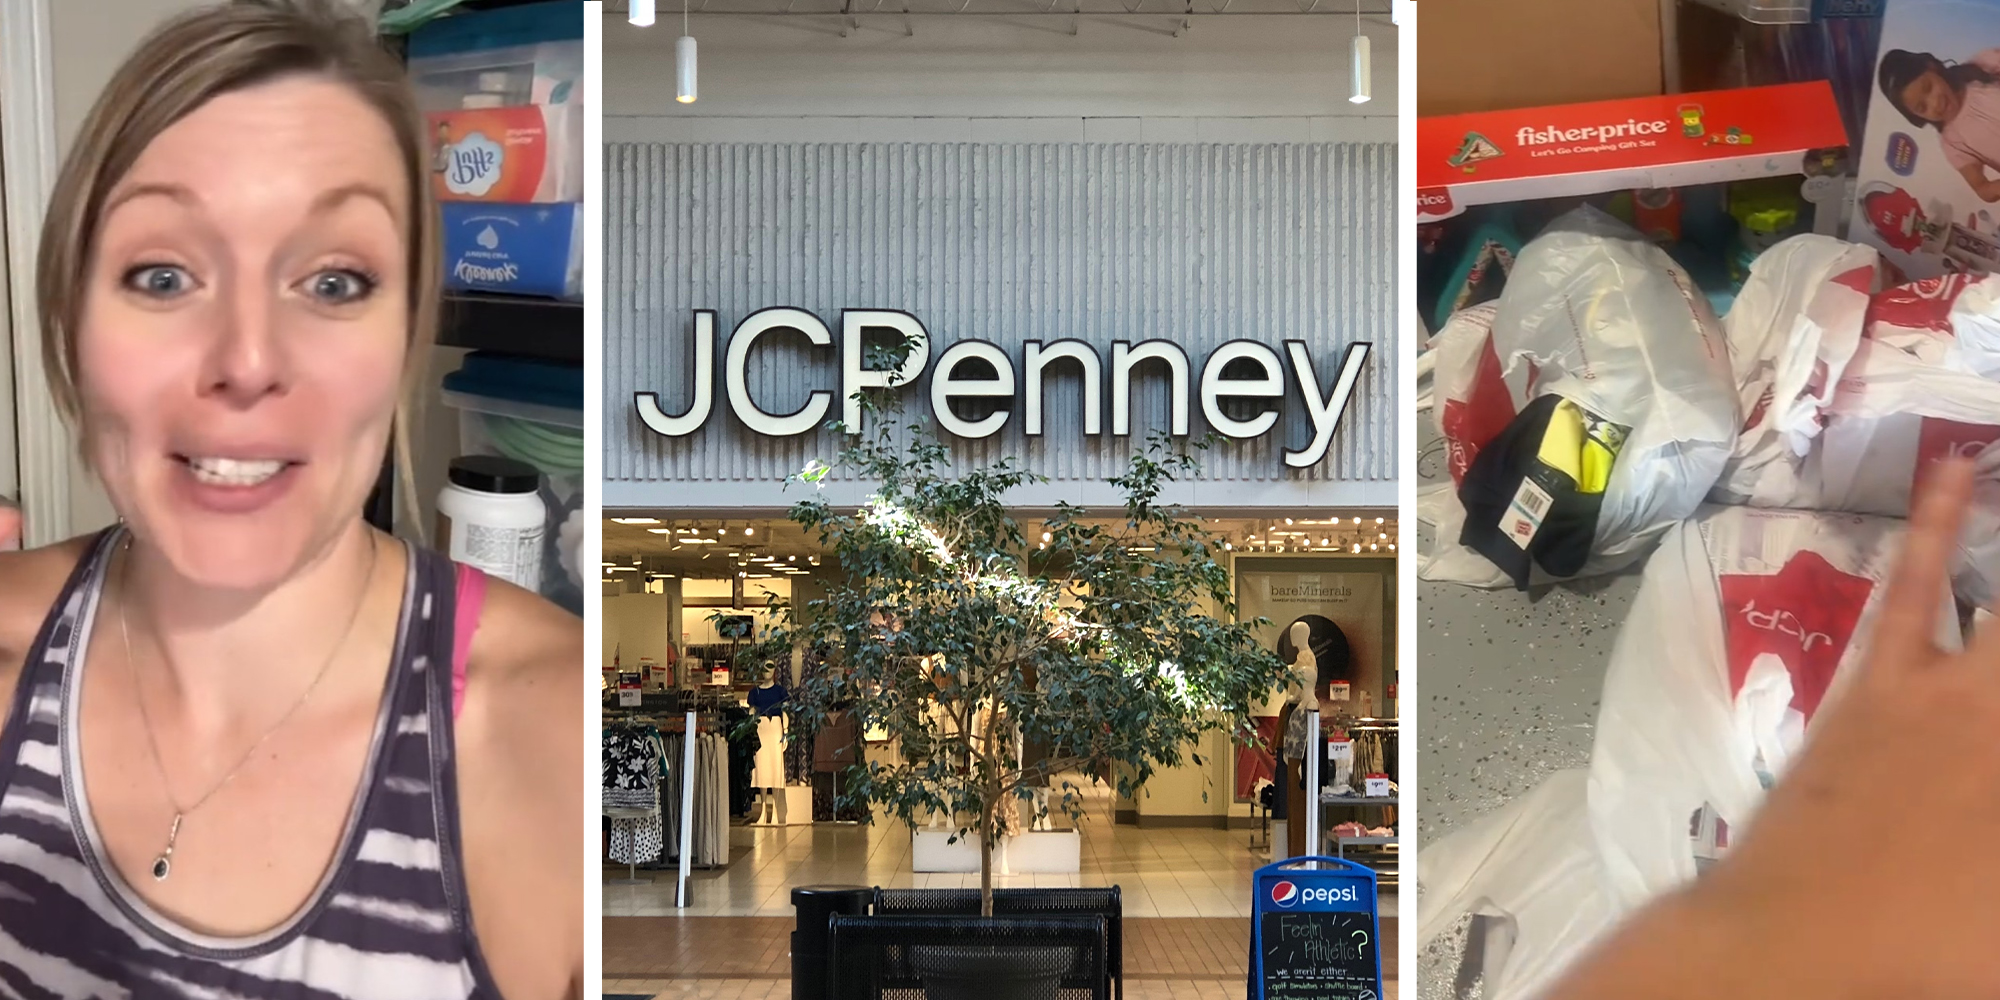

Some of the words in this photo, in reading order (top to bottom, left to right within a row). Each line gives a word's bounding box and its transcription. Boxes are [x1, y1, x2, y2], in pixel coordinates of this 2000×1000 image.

[1515, 119, 1667, 146] fisher-price
[1557, 147, 1572, 156] Go
[1573, 143, 1618, 155] Camping
[1619, 141, 1638, 150] Gift
[1639, 139, 1657, 148] Set
[634, 306, 1373, 468] JCPenney
[1271, 585, 1352, 597] bareMinerals
[1302, 885, 1356, 905] pepsi
[1272, 982, 1287, 995] golf
